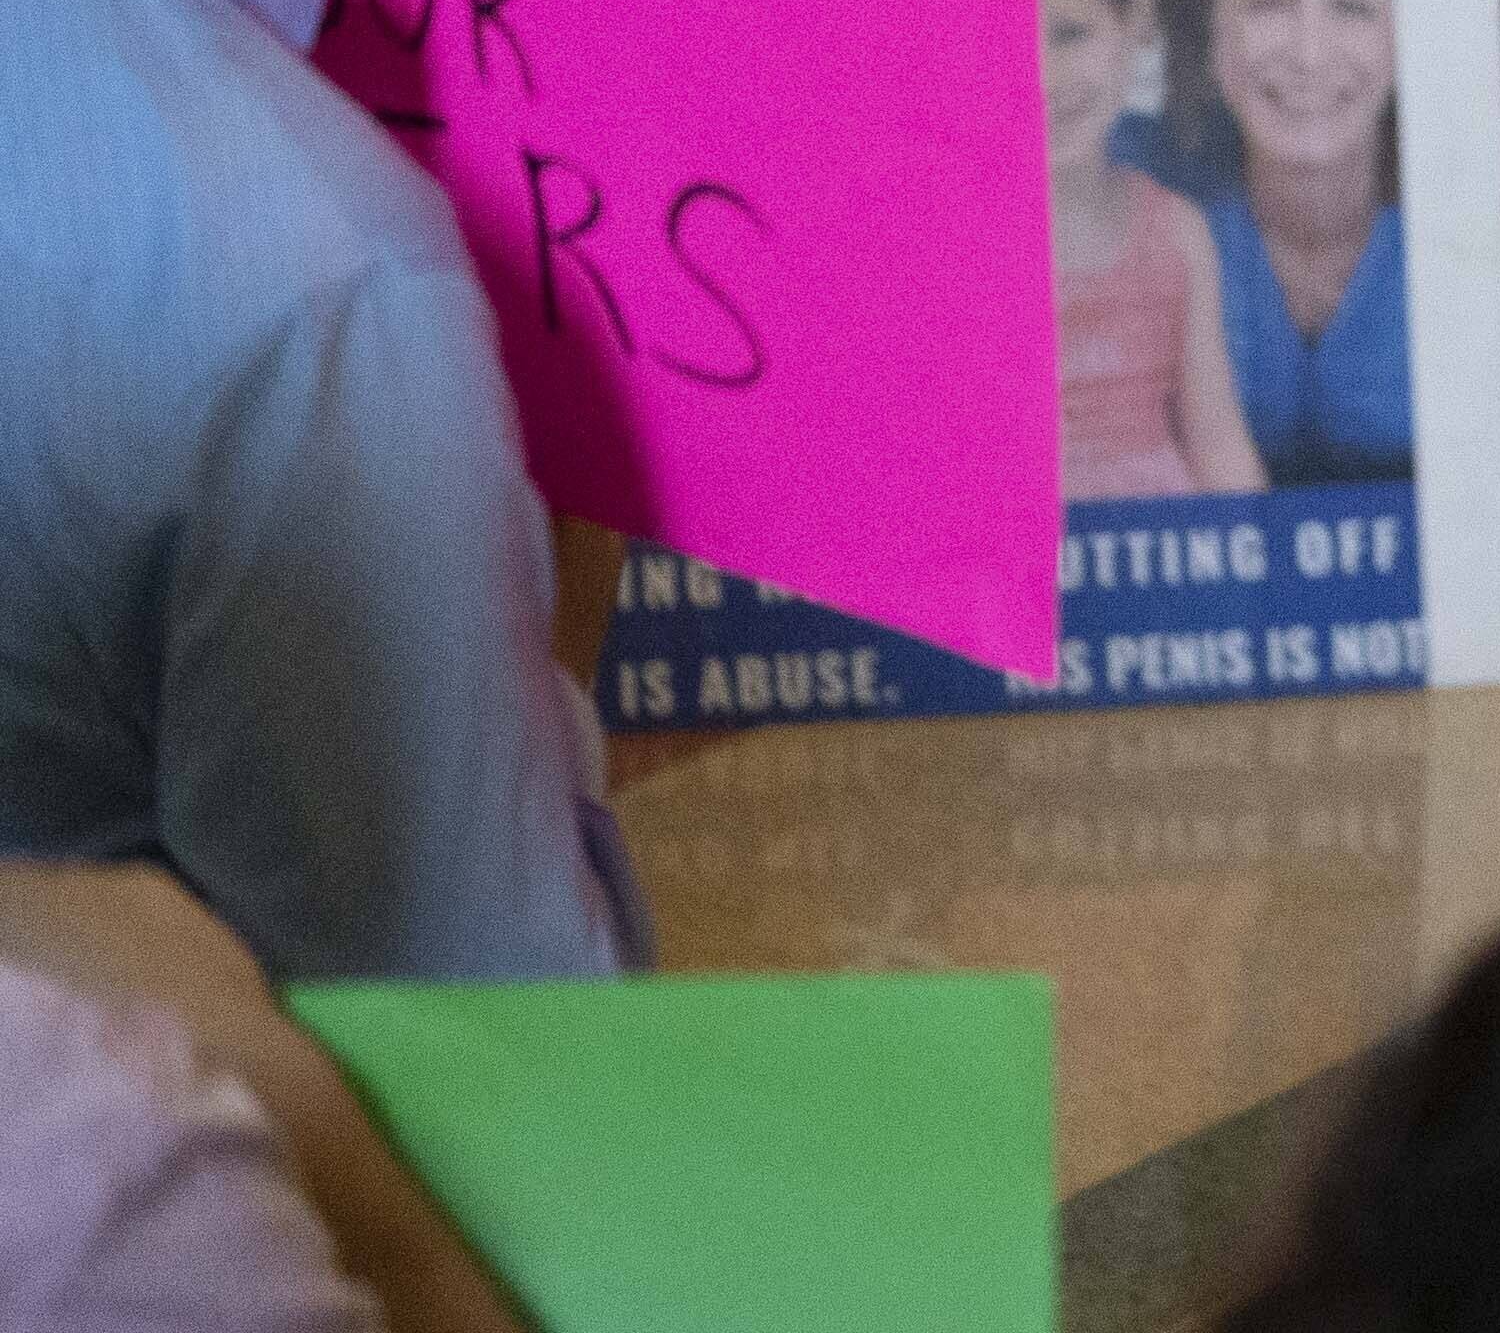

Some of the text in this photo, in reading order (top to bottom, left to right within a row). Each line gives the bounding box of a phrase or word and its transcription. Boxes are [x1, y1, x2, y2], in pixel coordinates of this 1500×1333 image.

[1058, 516, 1398, 591] UTTING OFF
[617, 658, 676, 721] IS
[1104, 631, 1253, 693] PENIS
[1265, 626, 1319, 683] IS
[1330, 619, 1430, 679] NOT
